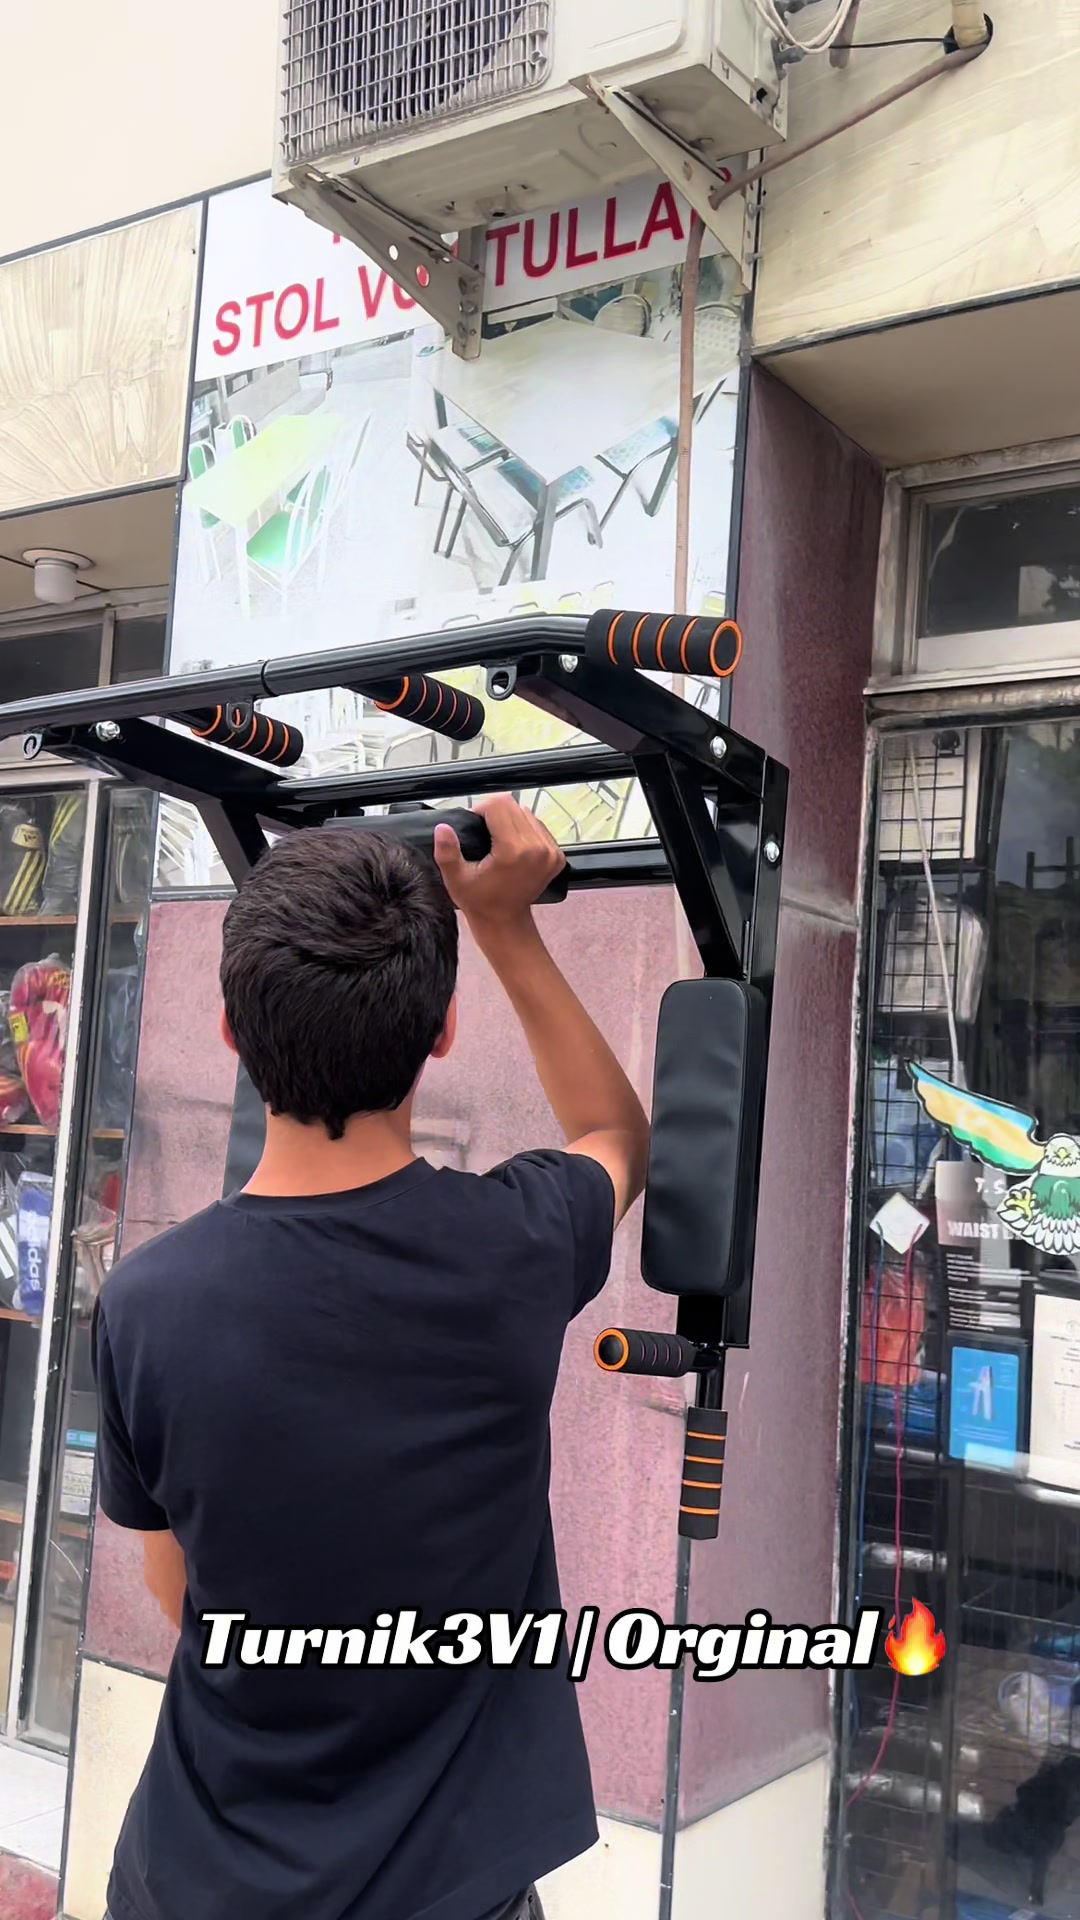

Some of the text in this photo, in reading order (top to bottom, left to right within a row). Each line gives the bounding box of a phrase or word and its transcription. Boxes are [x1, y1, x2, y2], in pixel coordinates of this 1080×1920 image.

[212, 276, 341, 357] STOL
[451, 167, 731, 287] TULLA
[947, 1220, 1000, 1239] WAIST
